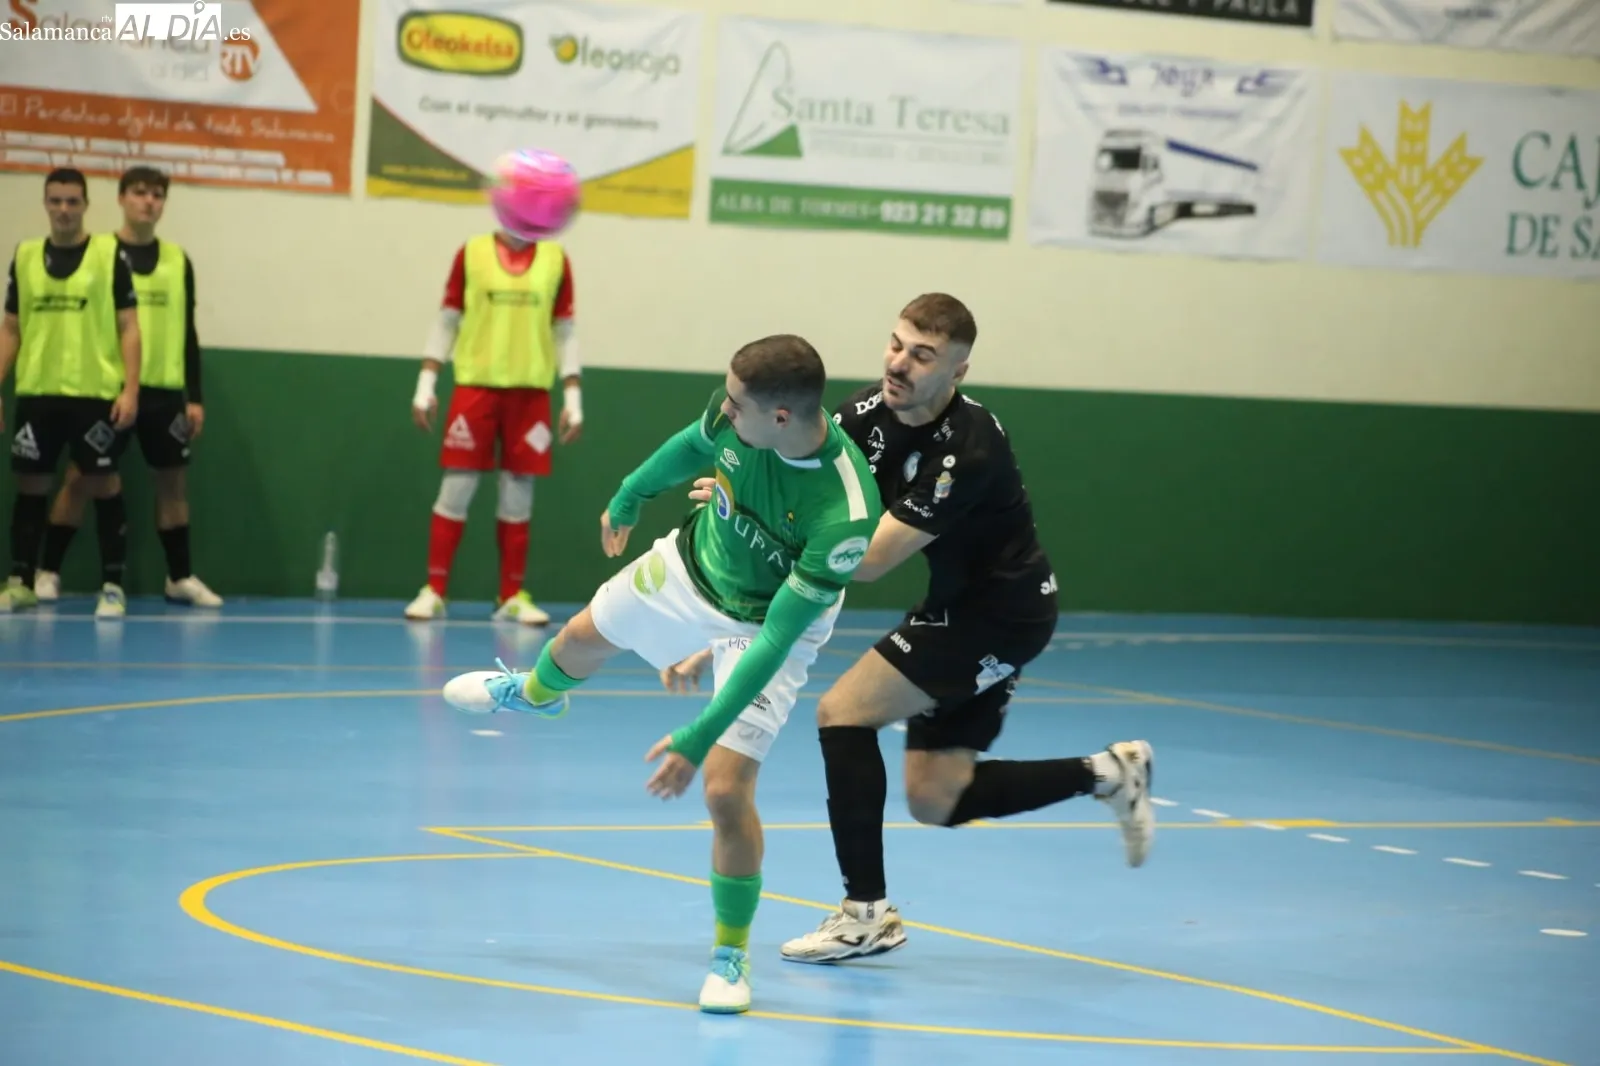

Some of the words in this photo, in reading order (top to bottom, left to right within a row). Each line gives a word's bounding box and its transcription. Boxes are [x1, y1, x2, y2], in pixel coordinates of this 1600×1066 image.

[771, 86, 876, 128] Santa
[888, 94, 1010, 136] Teresa
[1505, 212, 1561, 258] DE
[890, 632, 912, 654] JAKO
